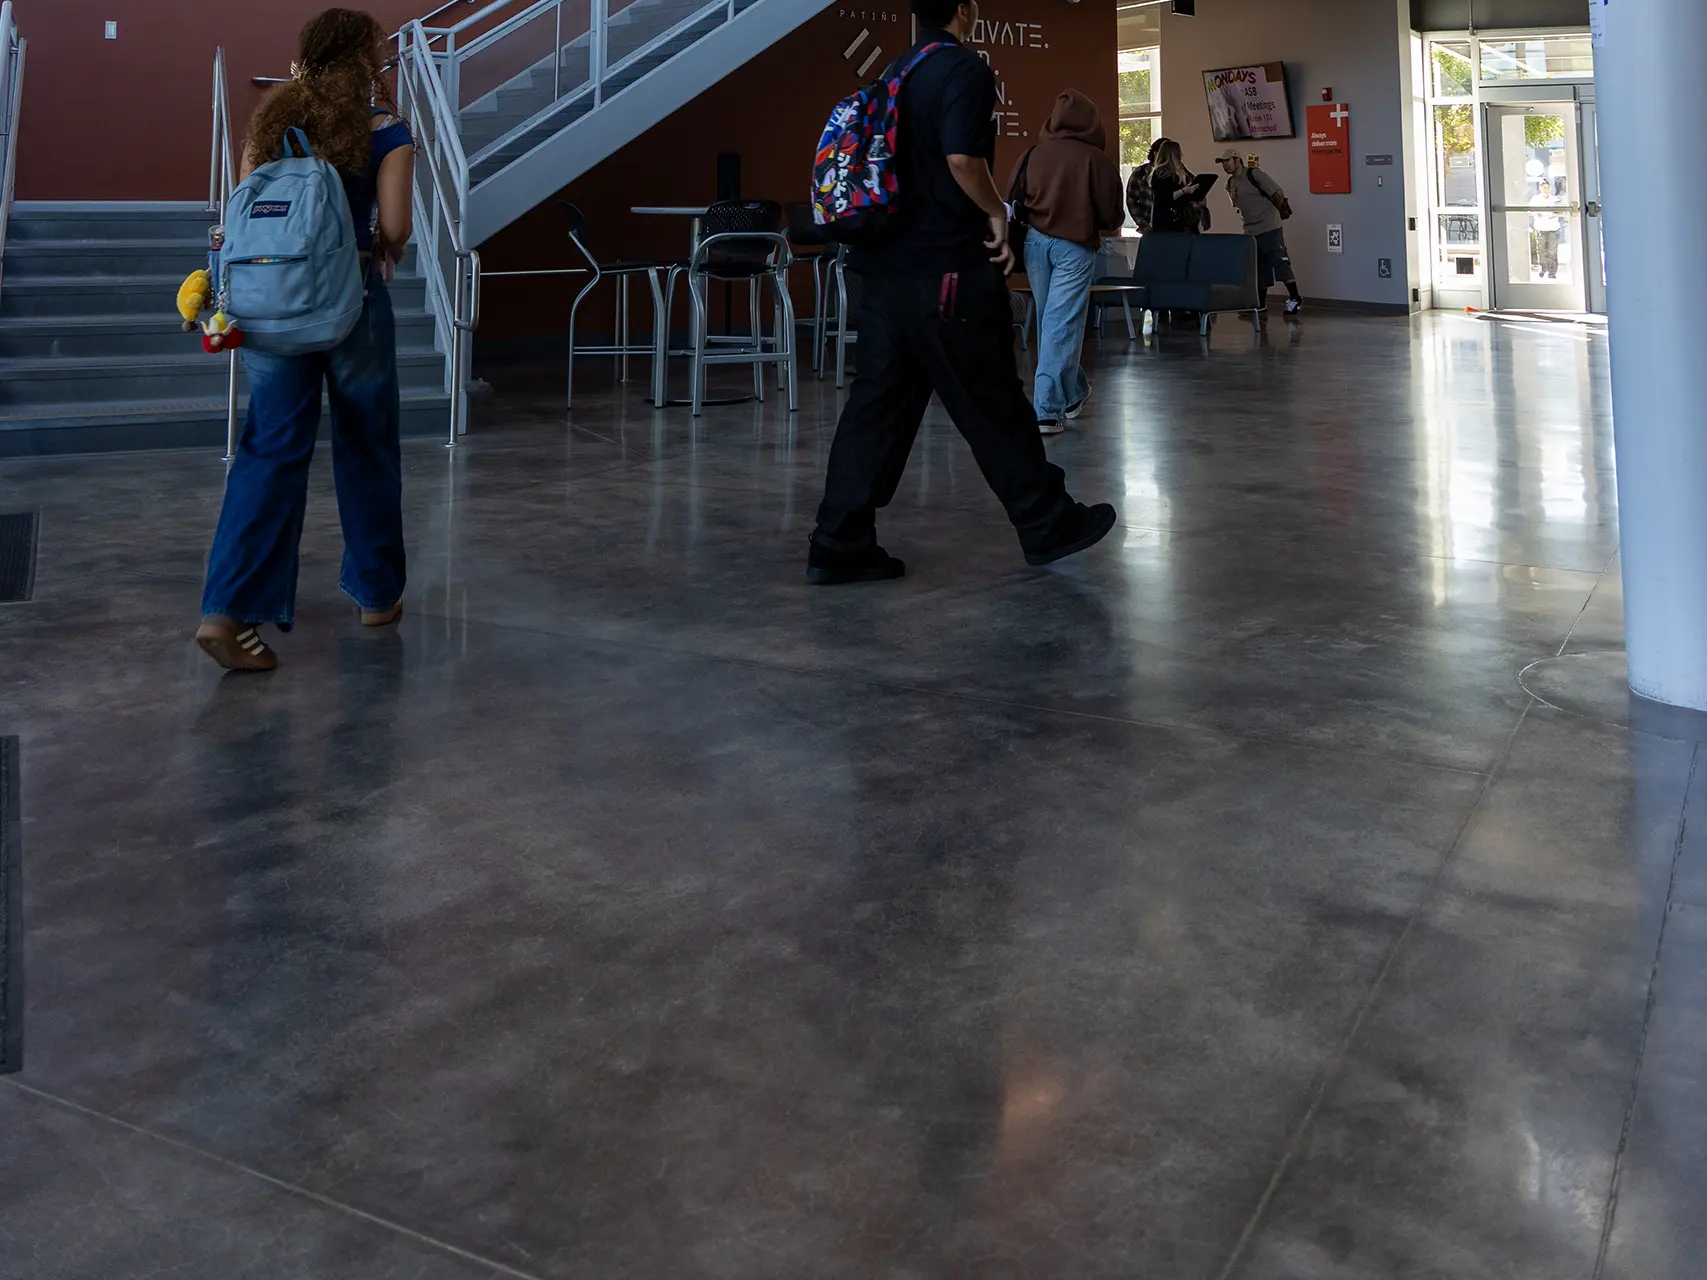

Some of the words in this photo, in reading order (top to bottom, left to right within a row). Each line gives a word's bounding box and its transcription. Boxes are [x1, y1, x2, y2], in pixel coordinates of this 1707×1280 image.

[839, 9, 897, 22] PATIÑO
[1207, 70, 1257, 94] MONDAYS
[1244, 86, 1257, 96] ASB
[1246, 100, 1276, 111] Meetings
[834, 152, 851, 213] シャドウ
